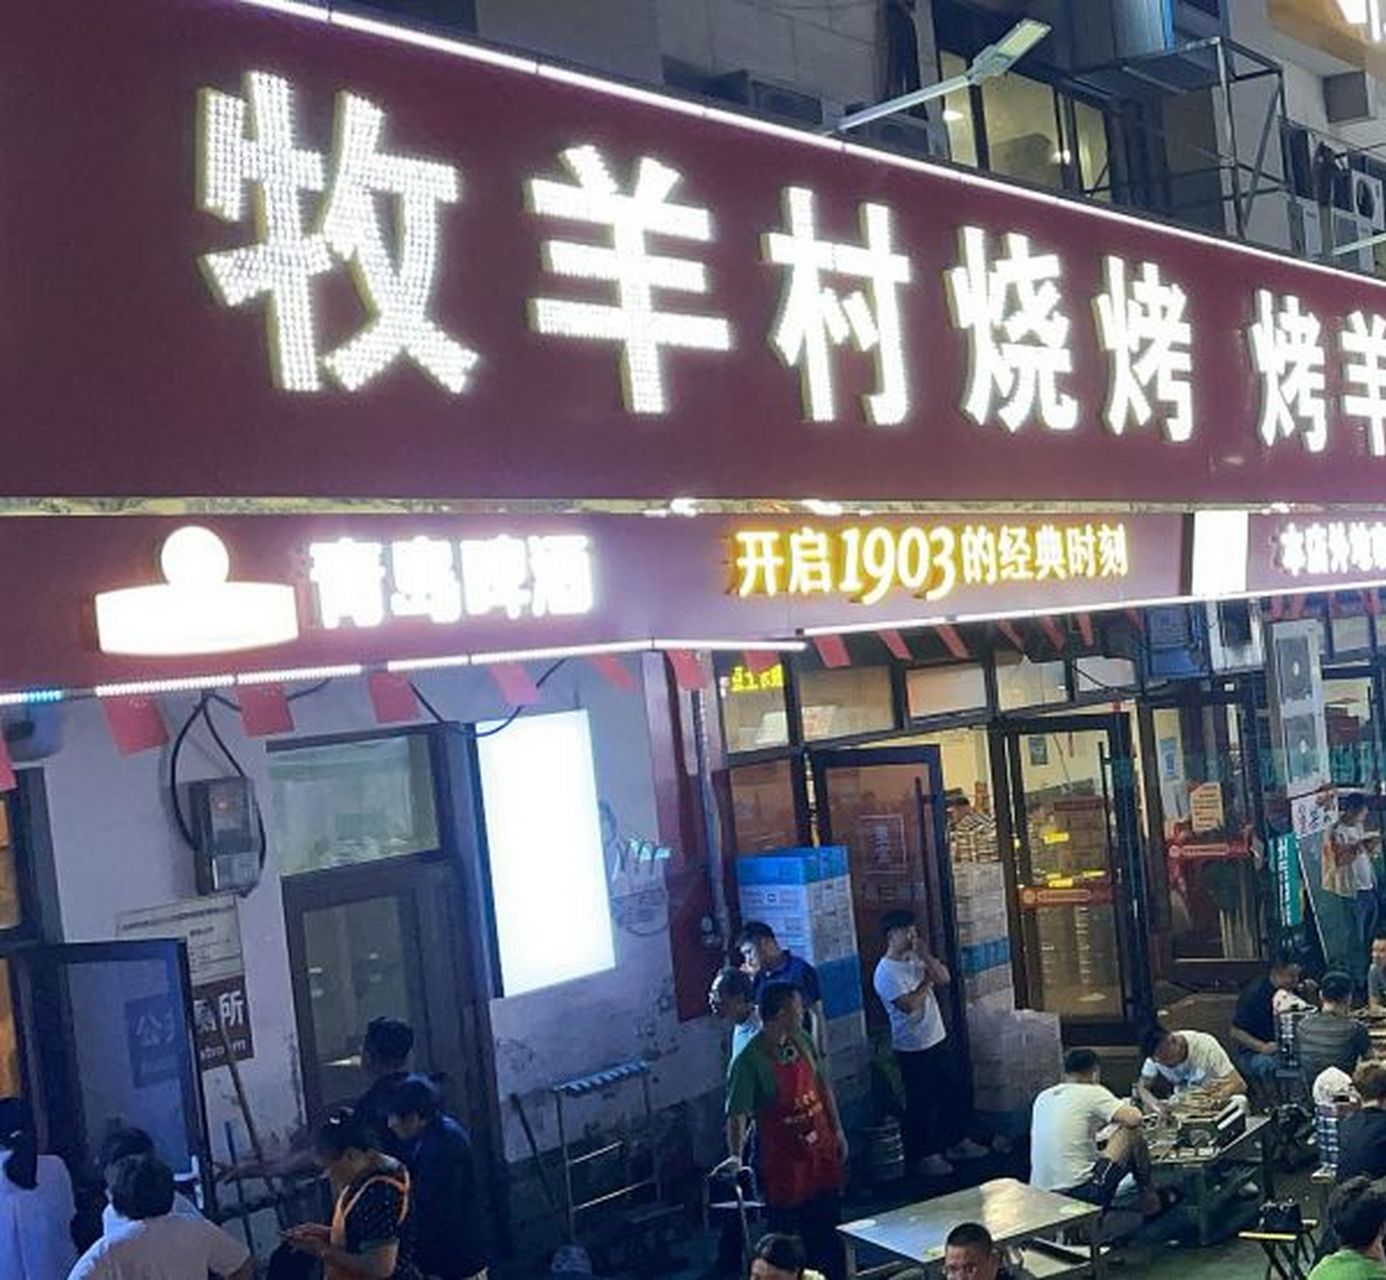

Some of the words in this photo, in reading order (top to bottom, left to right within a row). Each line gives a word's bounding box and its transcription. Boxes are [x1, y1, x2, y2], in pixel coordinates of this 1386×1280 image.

[198, 70, 1199, 443] 牧羊村烧烤
[307, 533, 597, 630] 青岛啤酒
[733, 522, 1131, 606] 开启1903的经典时刻
